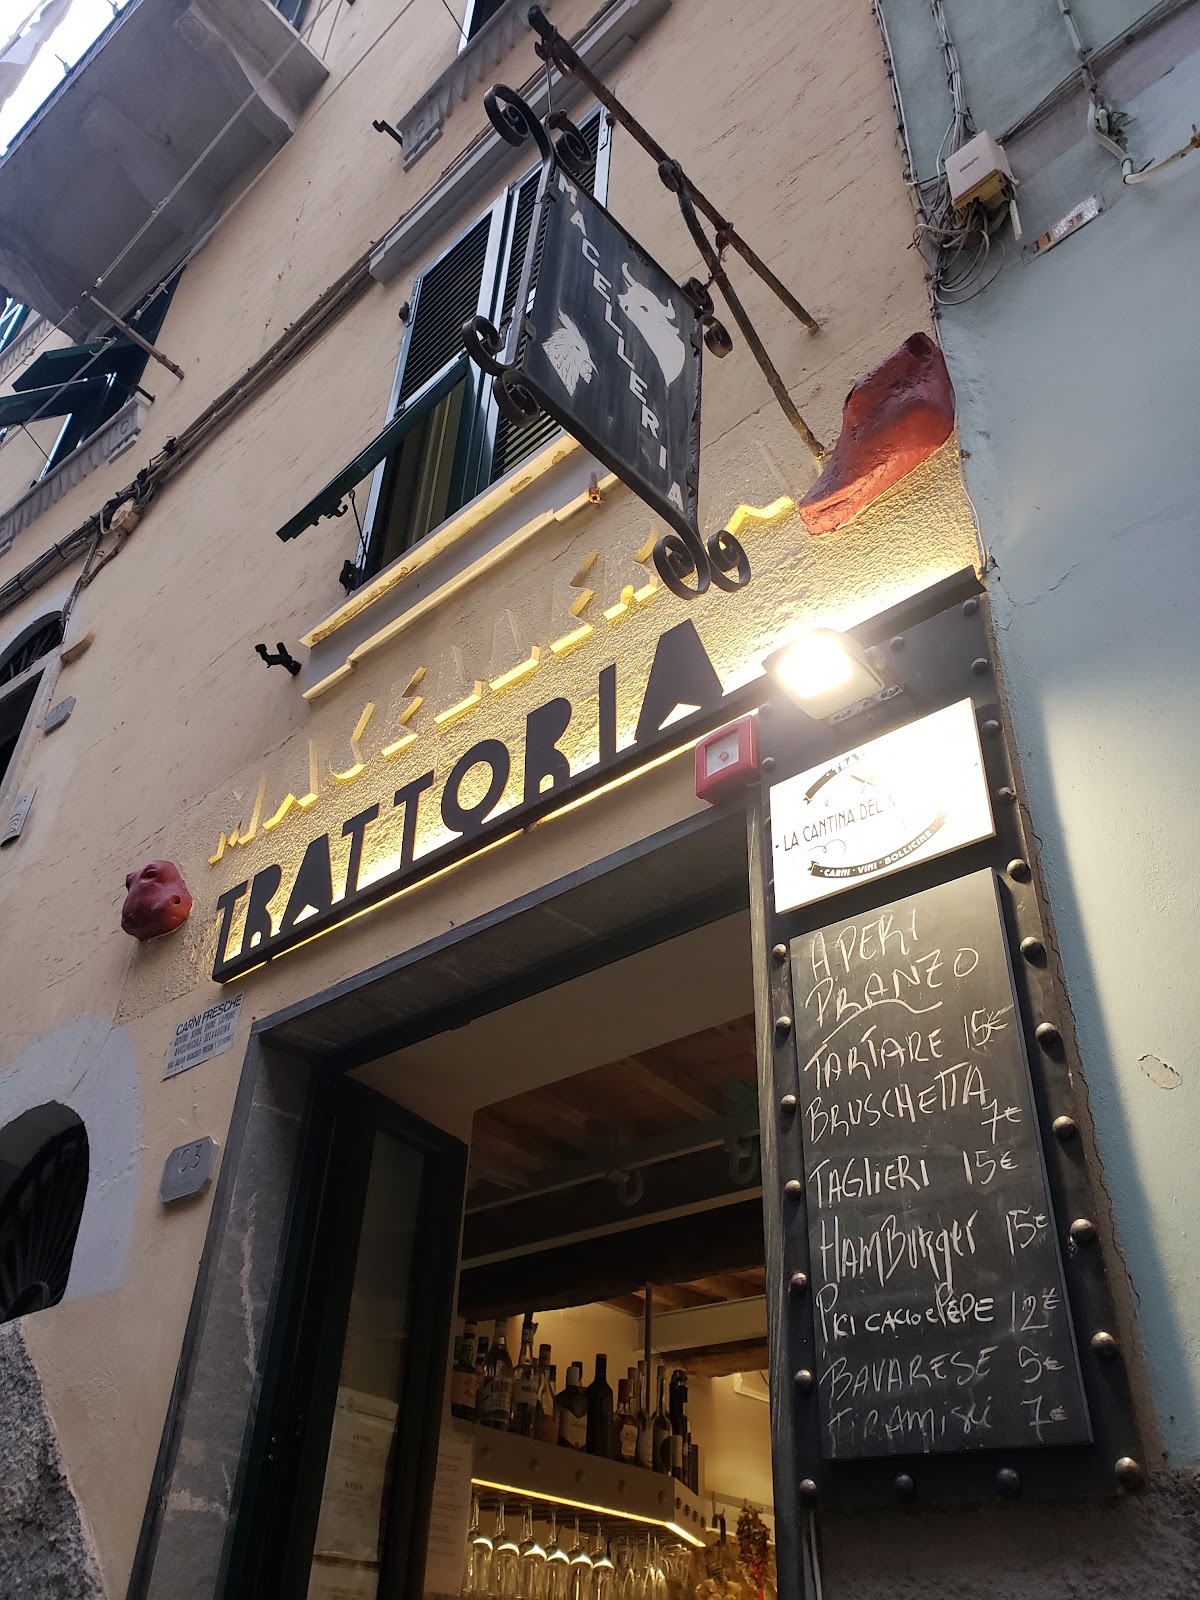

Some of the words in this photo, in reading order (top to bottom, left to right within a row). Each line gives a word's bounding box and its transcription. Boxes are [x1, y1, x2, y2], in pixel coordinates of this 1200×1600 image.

[558, 174, 684, 513] MACELLERIA
[213, 617, 724, 972] TRATTORIA
[783, 831, 799, 852] LA
[802, 808, 856, 843] CANTINA
[859, 797, 884, 820] DEL
[824, 867, 850, 877] CARNI
[857, 861, 878, 874] VINI
[176, 1015, 202, 1036] CARNI
[202, 993, 244, 1024] FRESCHE
[805, 948, 979, 1027] PRANZO
[803, 1025, 943, 1090] TARTARE
[805, 1061, 990, 1144] BRUSCHETTA
[963, 1150, 1018, 1185] 15€
[819, 1346, 999, 1401] BAVARESE
